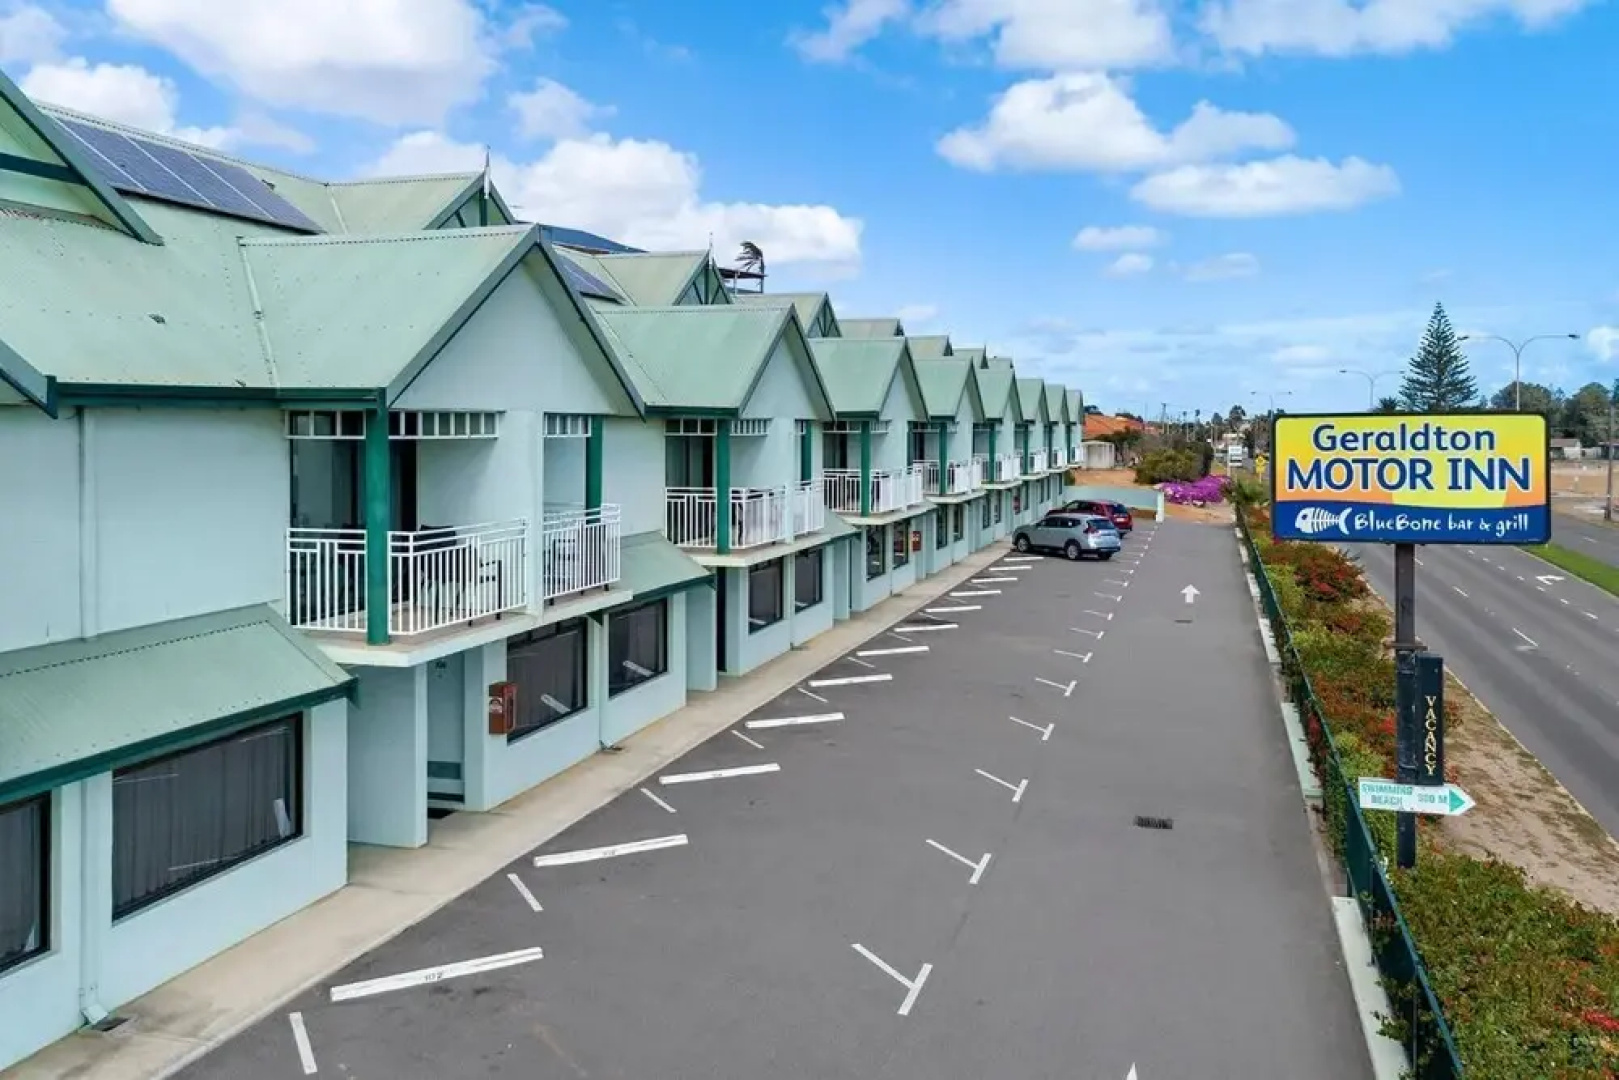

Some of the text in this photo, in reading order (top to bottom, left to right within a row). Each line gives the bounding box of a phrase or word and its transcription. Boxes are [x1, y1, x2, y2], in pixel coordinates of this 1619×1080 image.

[1313, 423, 1495, 451] Geraldton
[1288, 458, 1529, 490] MOTOR INN
[1354, 513, 1528, 536] BlueBone bar & grill
[1425, 695, 1437, 776] VACANCY
[1361, 783, 1413, 796] SWIMMING
[1371, 794, 1402, 806] BEACH
